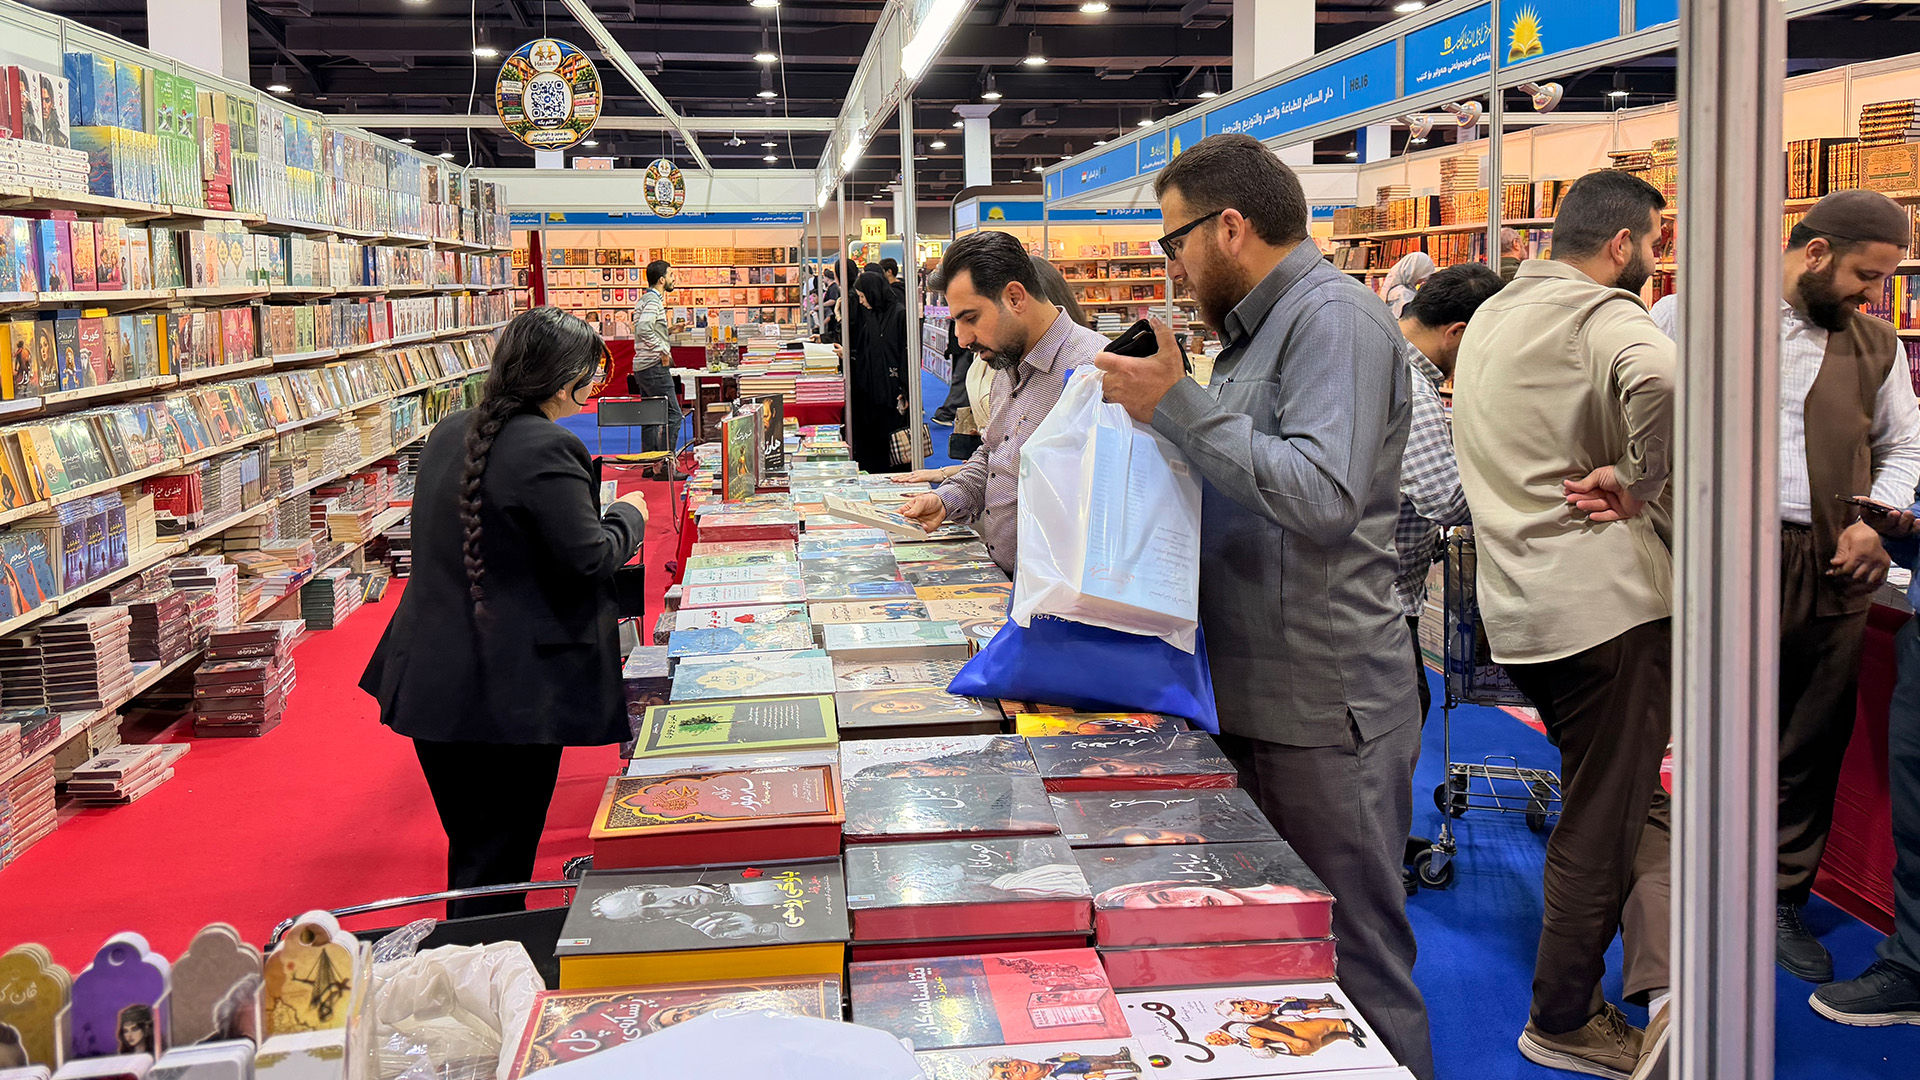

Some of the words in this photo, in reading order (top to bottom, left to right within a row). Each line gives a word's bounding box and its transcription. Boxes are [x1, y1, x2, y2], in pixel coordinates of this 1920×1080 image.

[1302, 90, 1323, 112] السلام
[1324, 86, 1334, 104] دار
[1262, 106, 1281, 125] والنشر
[1281, 98, 1302, 115] للطباعة
[1241, 113, 1262, 132] والتوزيع
